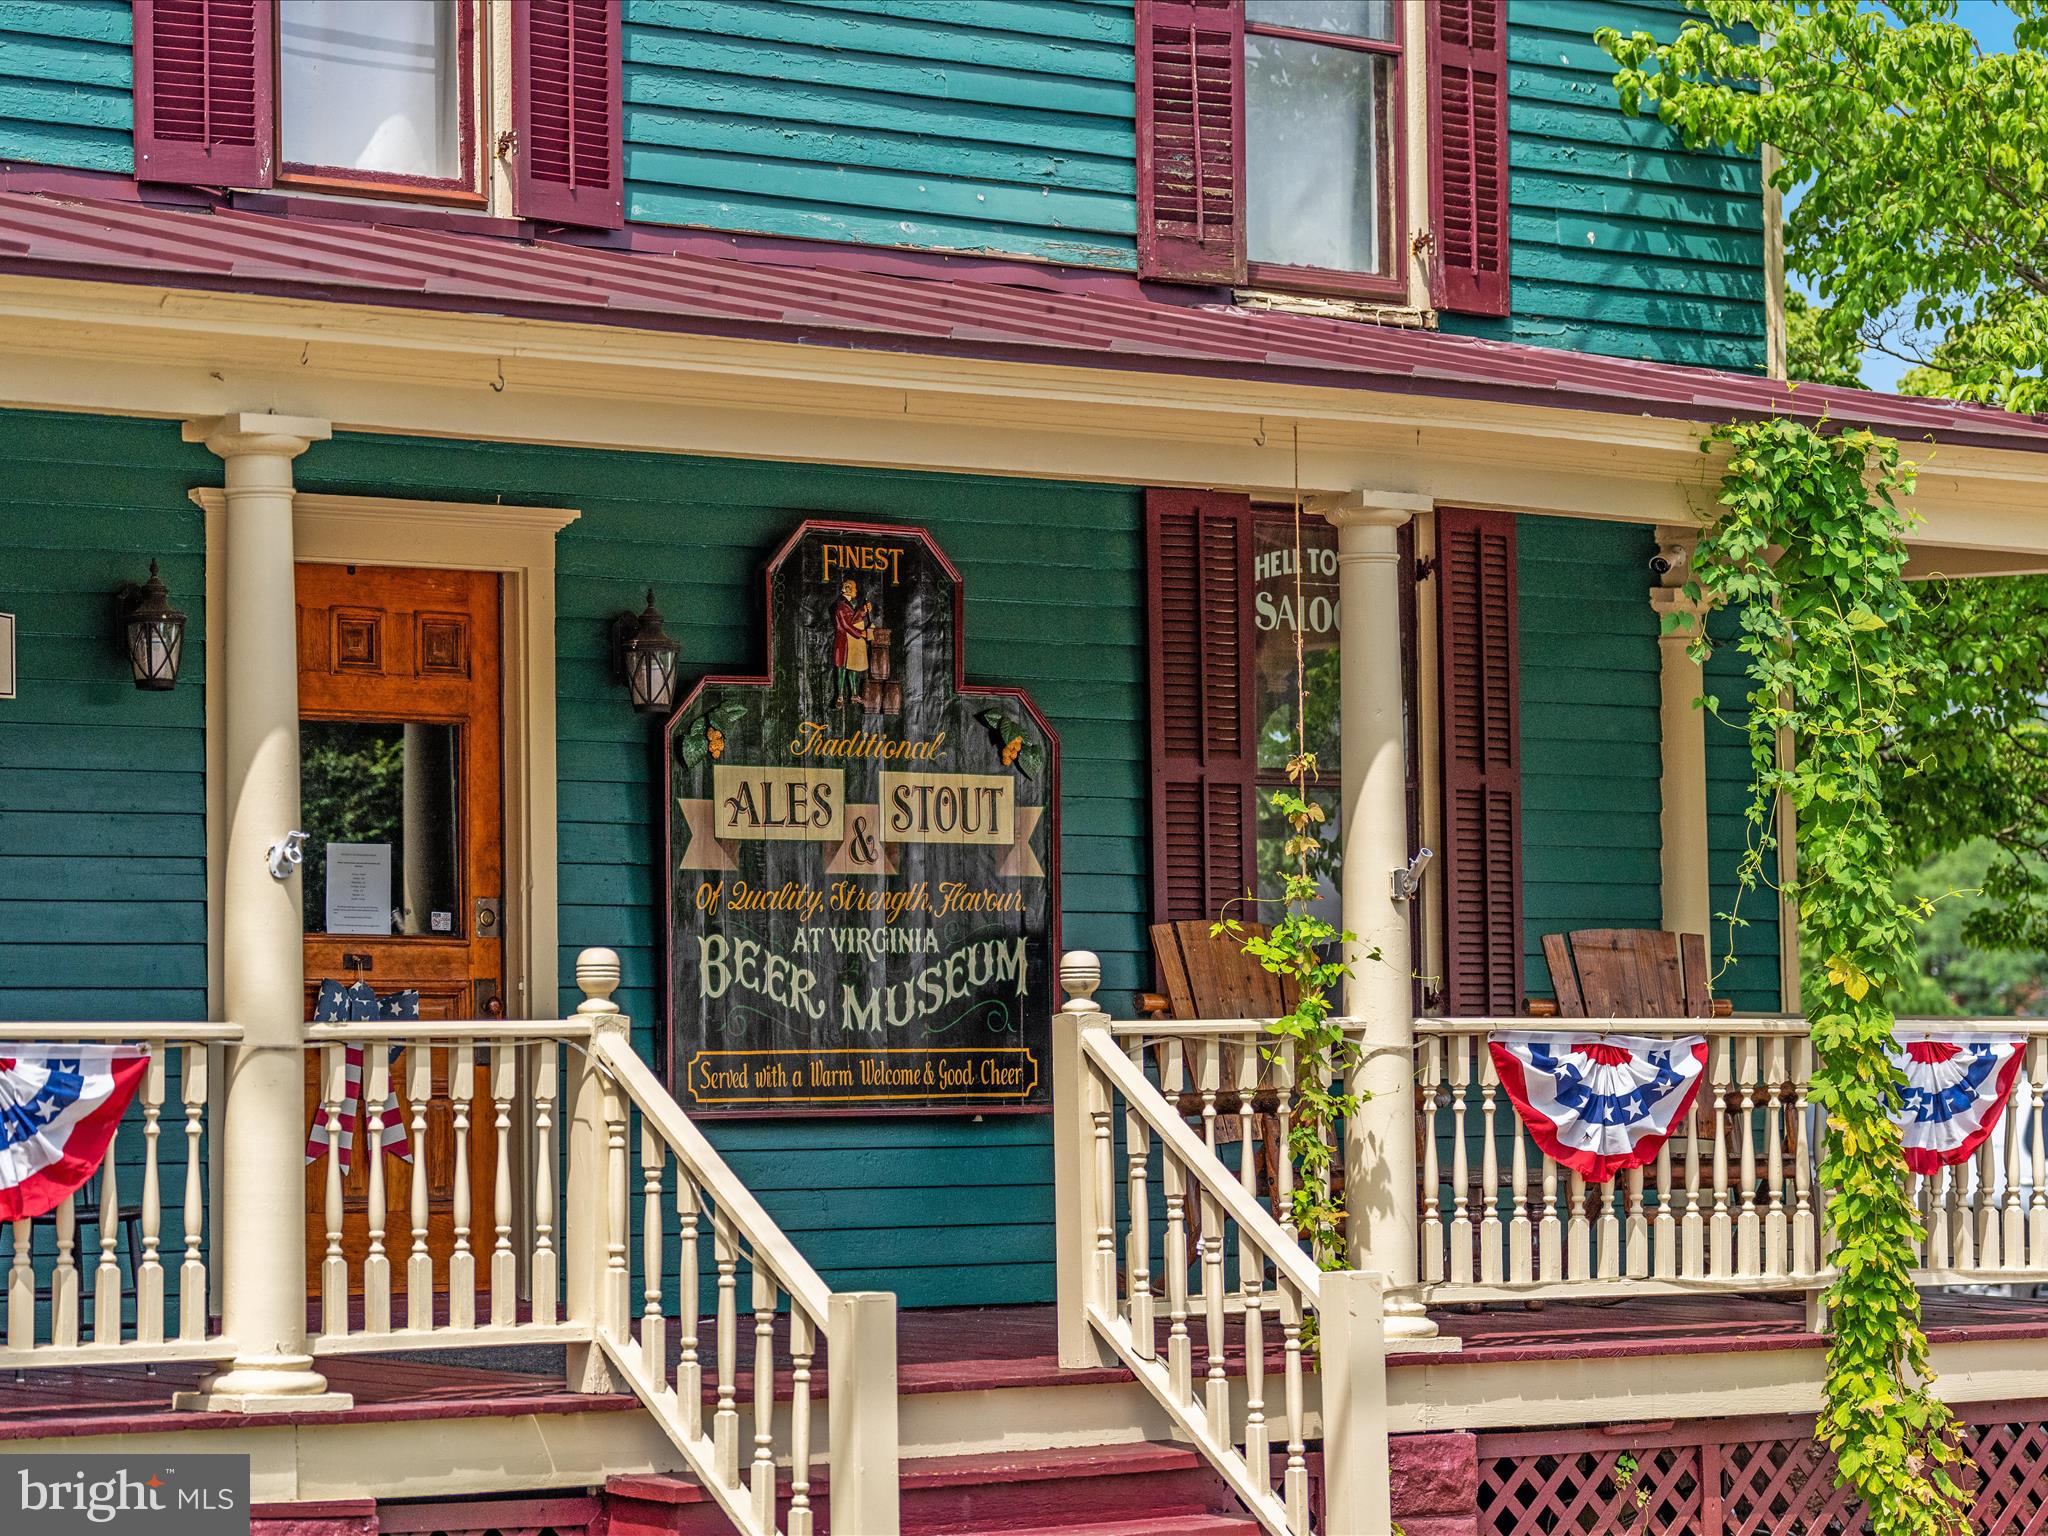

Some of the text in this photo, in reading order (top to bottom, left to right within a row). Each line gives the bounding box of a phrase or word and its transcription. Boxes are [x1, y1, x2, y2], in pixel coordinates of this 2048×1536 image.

[822, 544, 904, 586] FINEST
[1255, 548, 1339, 582] HELL TO
[790, 721, 947, 761] Traditional
[724, 780, 1004, 835] ALES STOUT
[850, 815, 880, 865] &
[695, 880, 1027, 924] Of Quality, Strength, Flavour.
[791, 927, 940, 962] AT VIRGINIA
[697, 934, 1029, 1033] BEER MUSEUM
[700, 1058, 1022, 1090] Served with a Warm Welcome & Good Cheer
